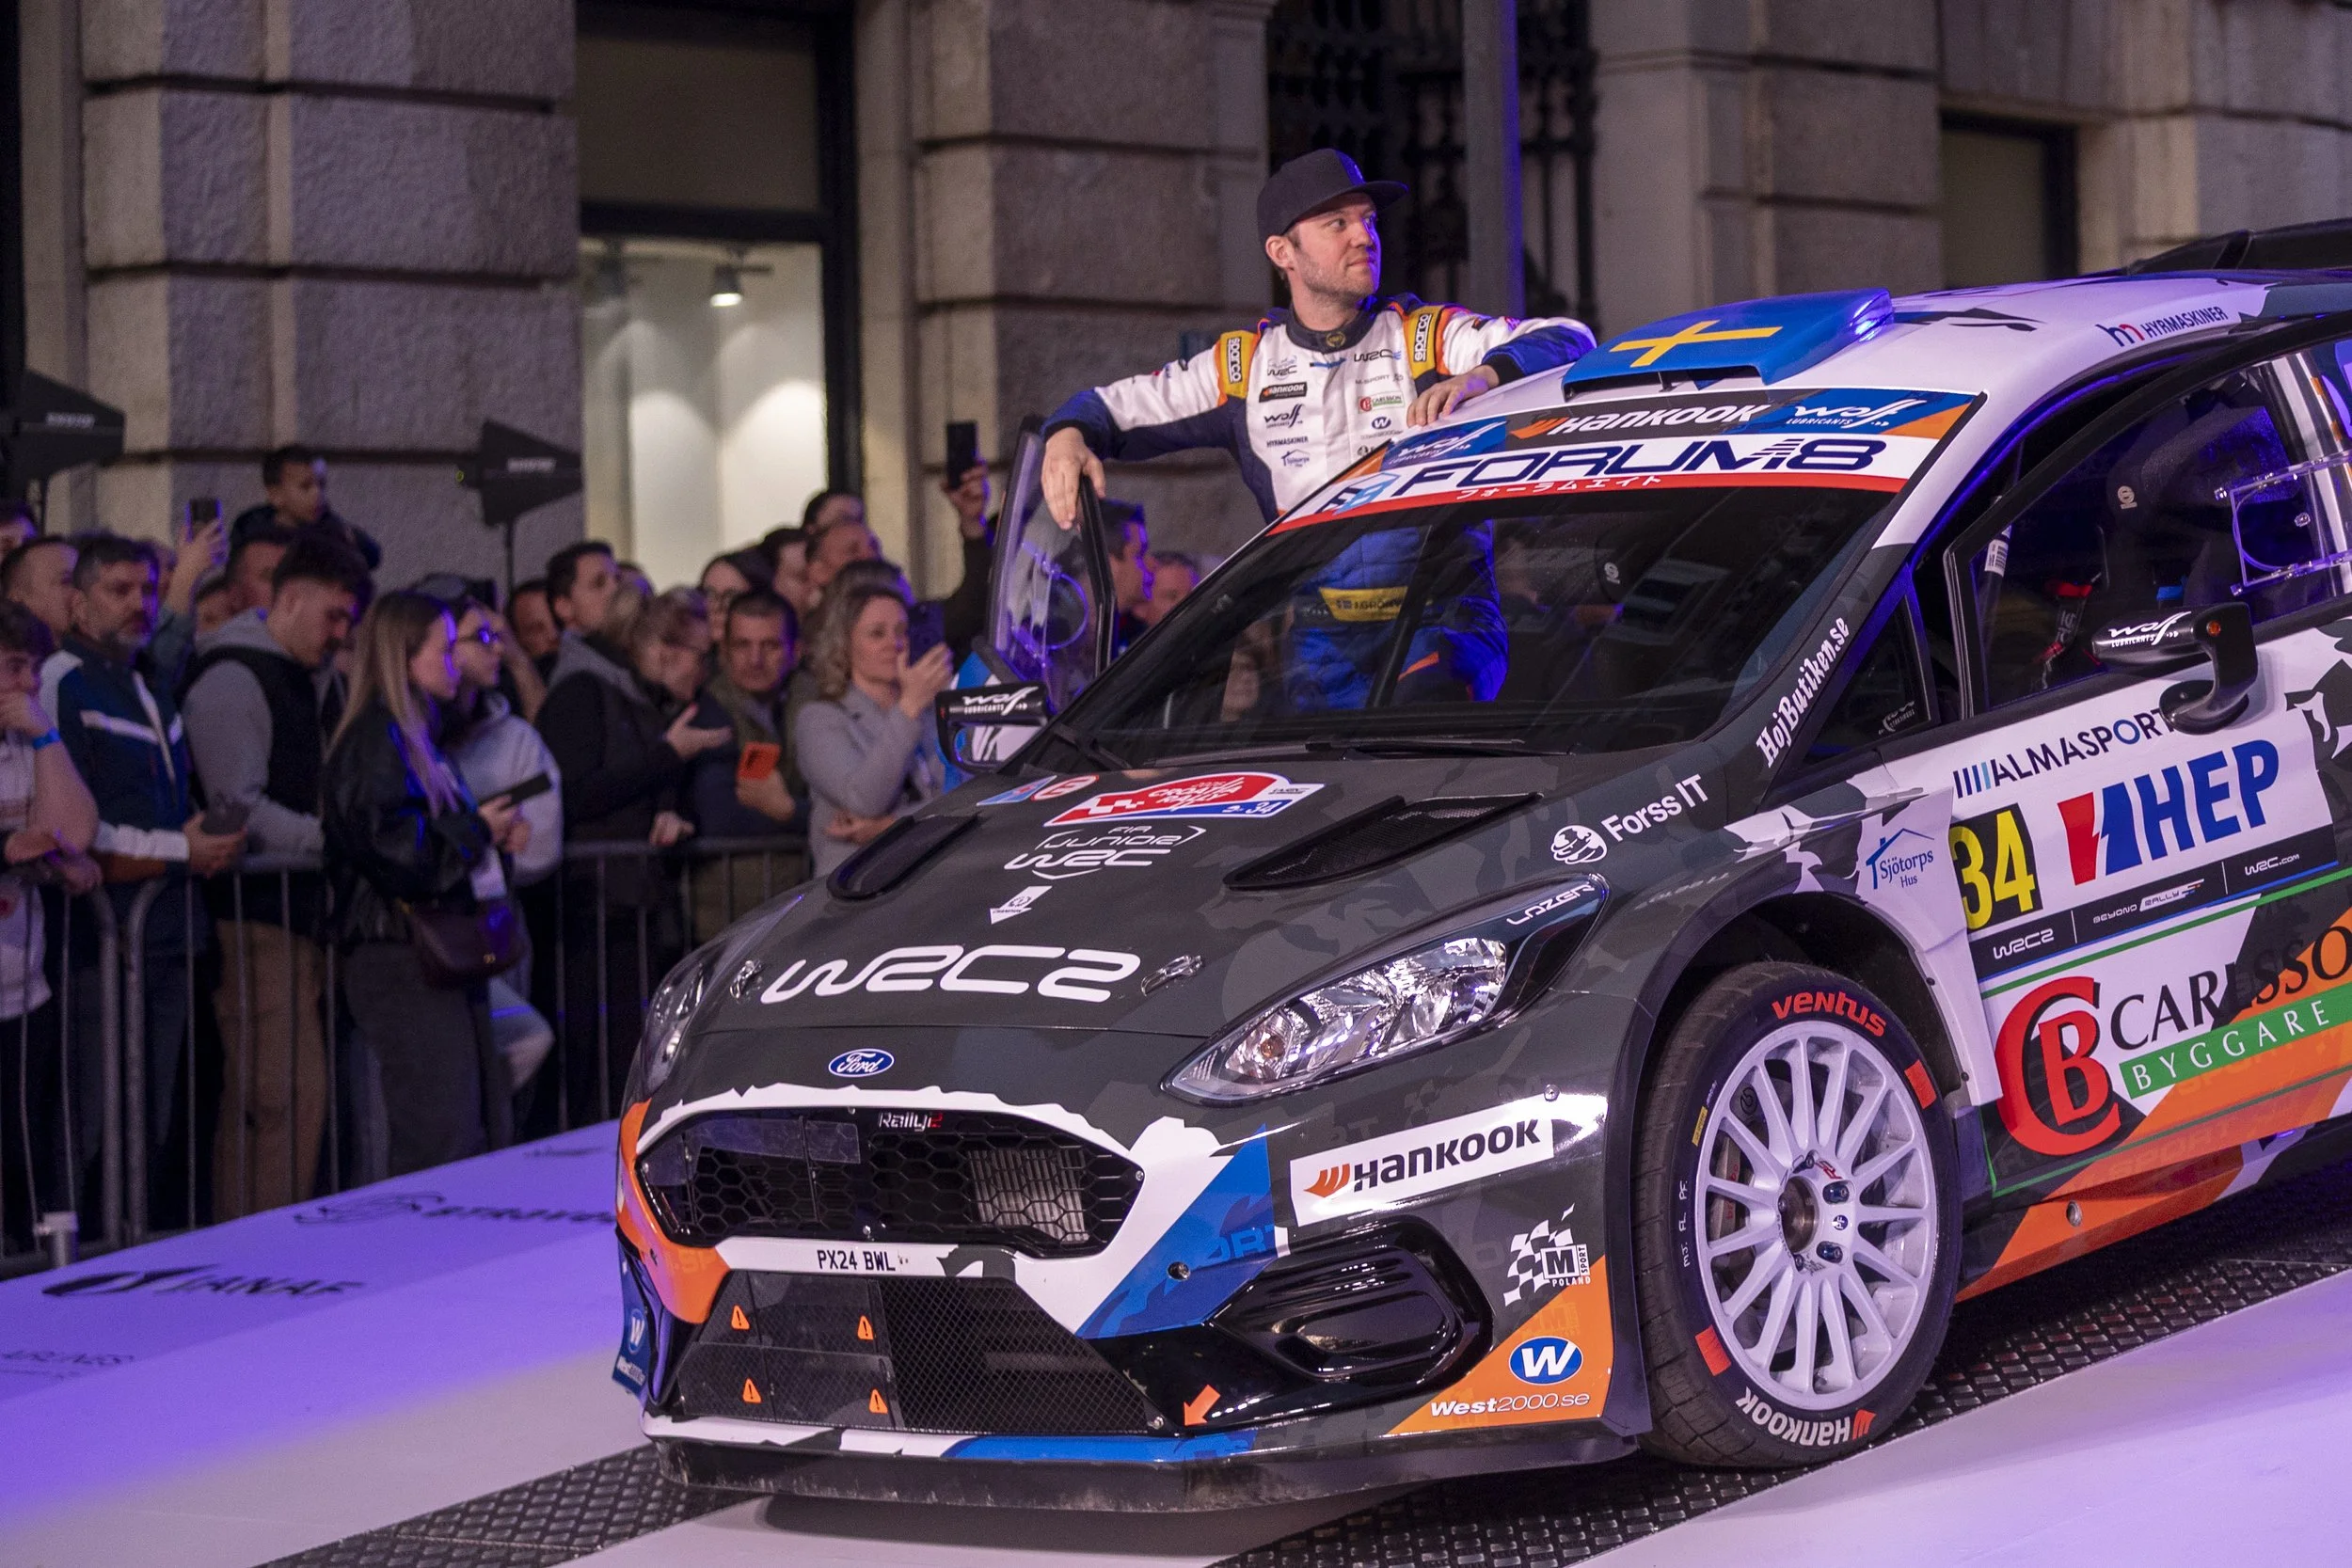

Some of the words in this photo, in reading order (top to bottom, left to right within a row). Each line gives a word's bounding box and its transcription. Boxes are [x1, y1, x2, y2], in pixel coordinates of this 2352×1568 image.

[2140, 307, 2229, 339] HYRMASKINER
[1414, 313, 1432, 361] sparco
[1228, 338, 1241, 383] sparco
[1786, 418, 1853, 427] LUBRICANTS
[1266, 436, 1309, 448] HYRMASKINER
[1391, 437, 1887, 498] FORUM8
[1457, 475, 1661, 500] フォーラムエイト
[2111, 635, 2154, 648] LUBRICANTS
[964, 704, 1005, 715] LUBRICANTS
[1601, 795, 1682, 842] Forss
[1676, 774, 1708, 808] IT
[1044, 834, 1183, 848] JUNIOR
[1108, 826, 1152, 834] FIA
[1004, 848, 1171, 869] WRC
[1880, 850, 1934, 882] Sjötorps
[1948, 810, 2036, 929] 34
[1900, 875, 1918, 888] Hus
[2093, 903, 2138, 924] BEYOND
[2145, 890, 2181, 906] RALLY
[1993, 928, 2055, 959] WRC2
[761, 944, 1141, 1005] WRC2
[2132, 1000, 2330, 1091] BYGGARE
[838, 1051, 881, 1074] Ford
[817, 1249, 858, 1270] PX24
[864, 1250, 896, 1271] BWL
[1545, 1249, 1568, 1275] M
[1579, 1246, 1589, 1274] SPORT
[1552, 1275, 1592, 1288] POLAND
[1521, 1340, 1579, 1378] W
[1430, 1392, 1590, 1418] West2000.se
